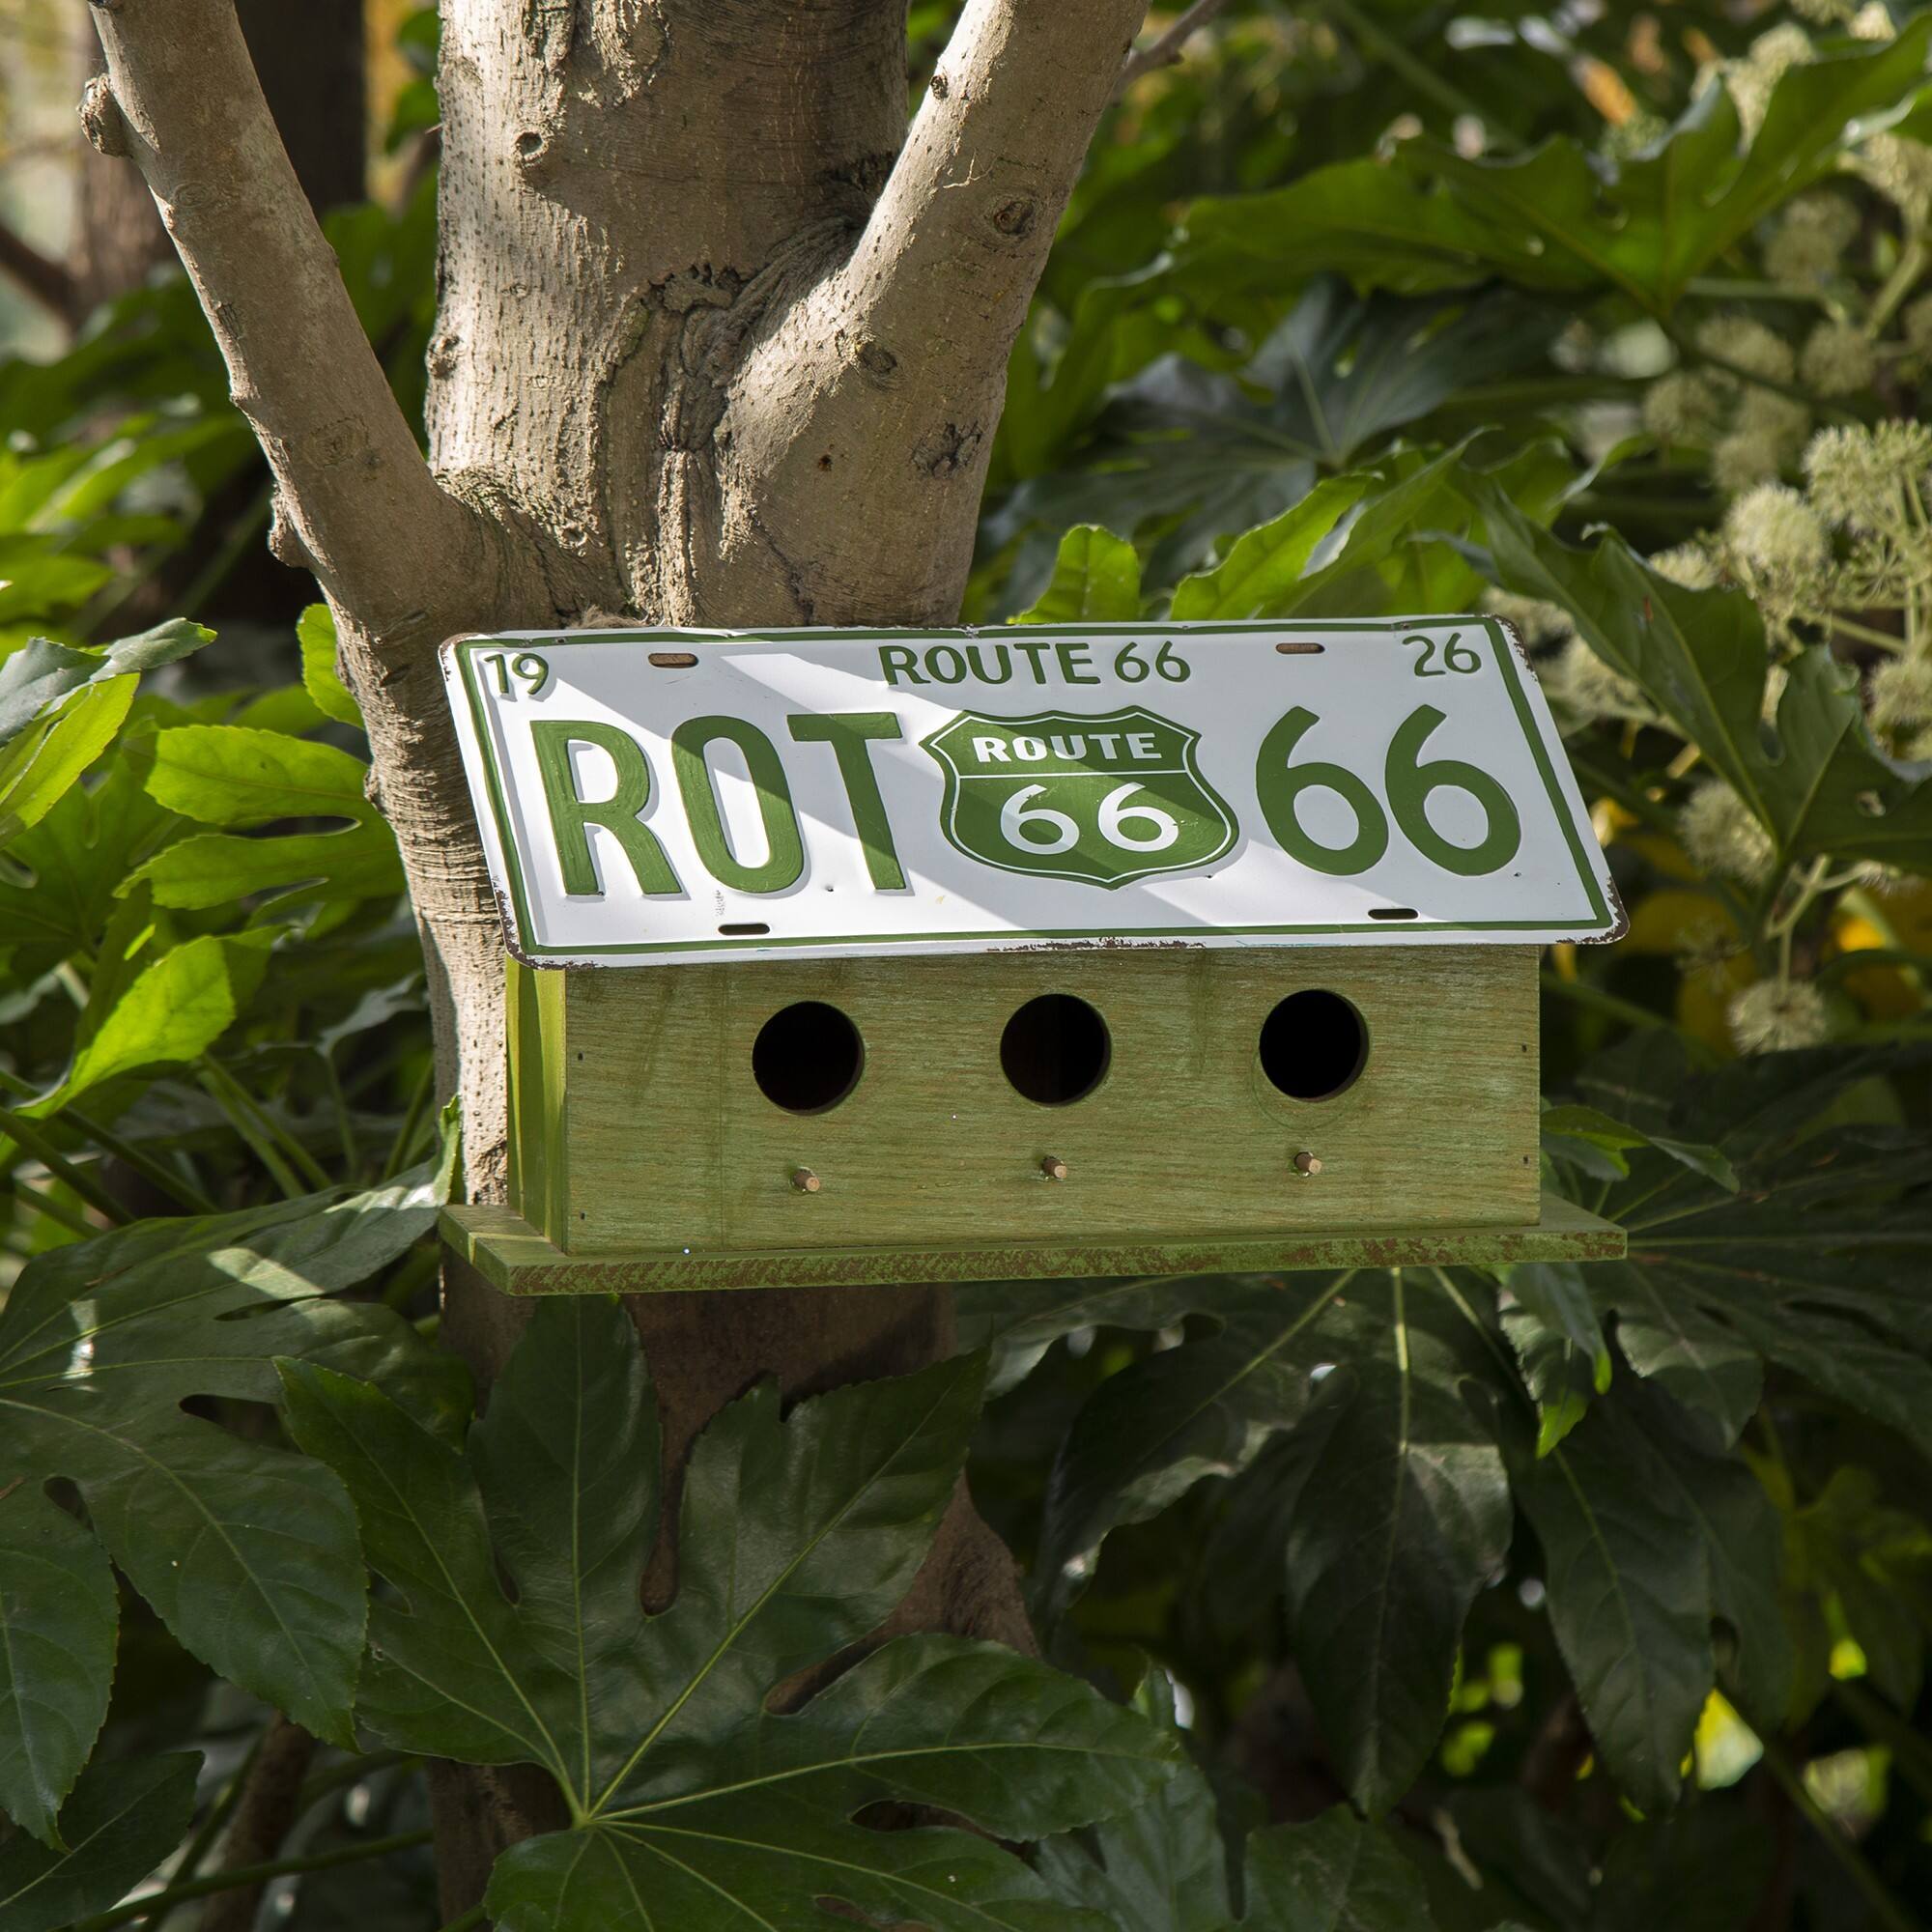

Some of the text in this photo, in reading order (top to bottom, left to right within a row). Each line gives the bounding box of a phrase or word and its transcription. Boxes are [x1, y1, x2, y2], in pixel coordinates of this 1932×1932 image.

[484, 652, 549, 695] 19
[878, 640, 1191, 686] ROUTE 66
[1403, 633, 1481, 677] 26
[973, 731, 1162, 763] ROUTE
[530, 704, 1521, 895] ROT 66
[1001, 782, 1179, 854] 66
